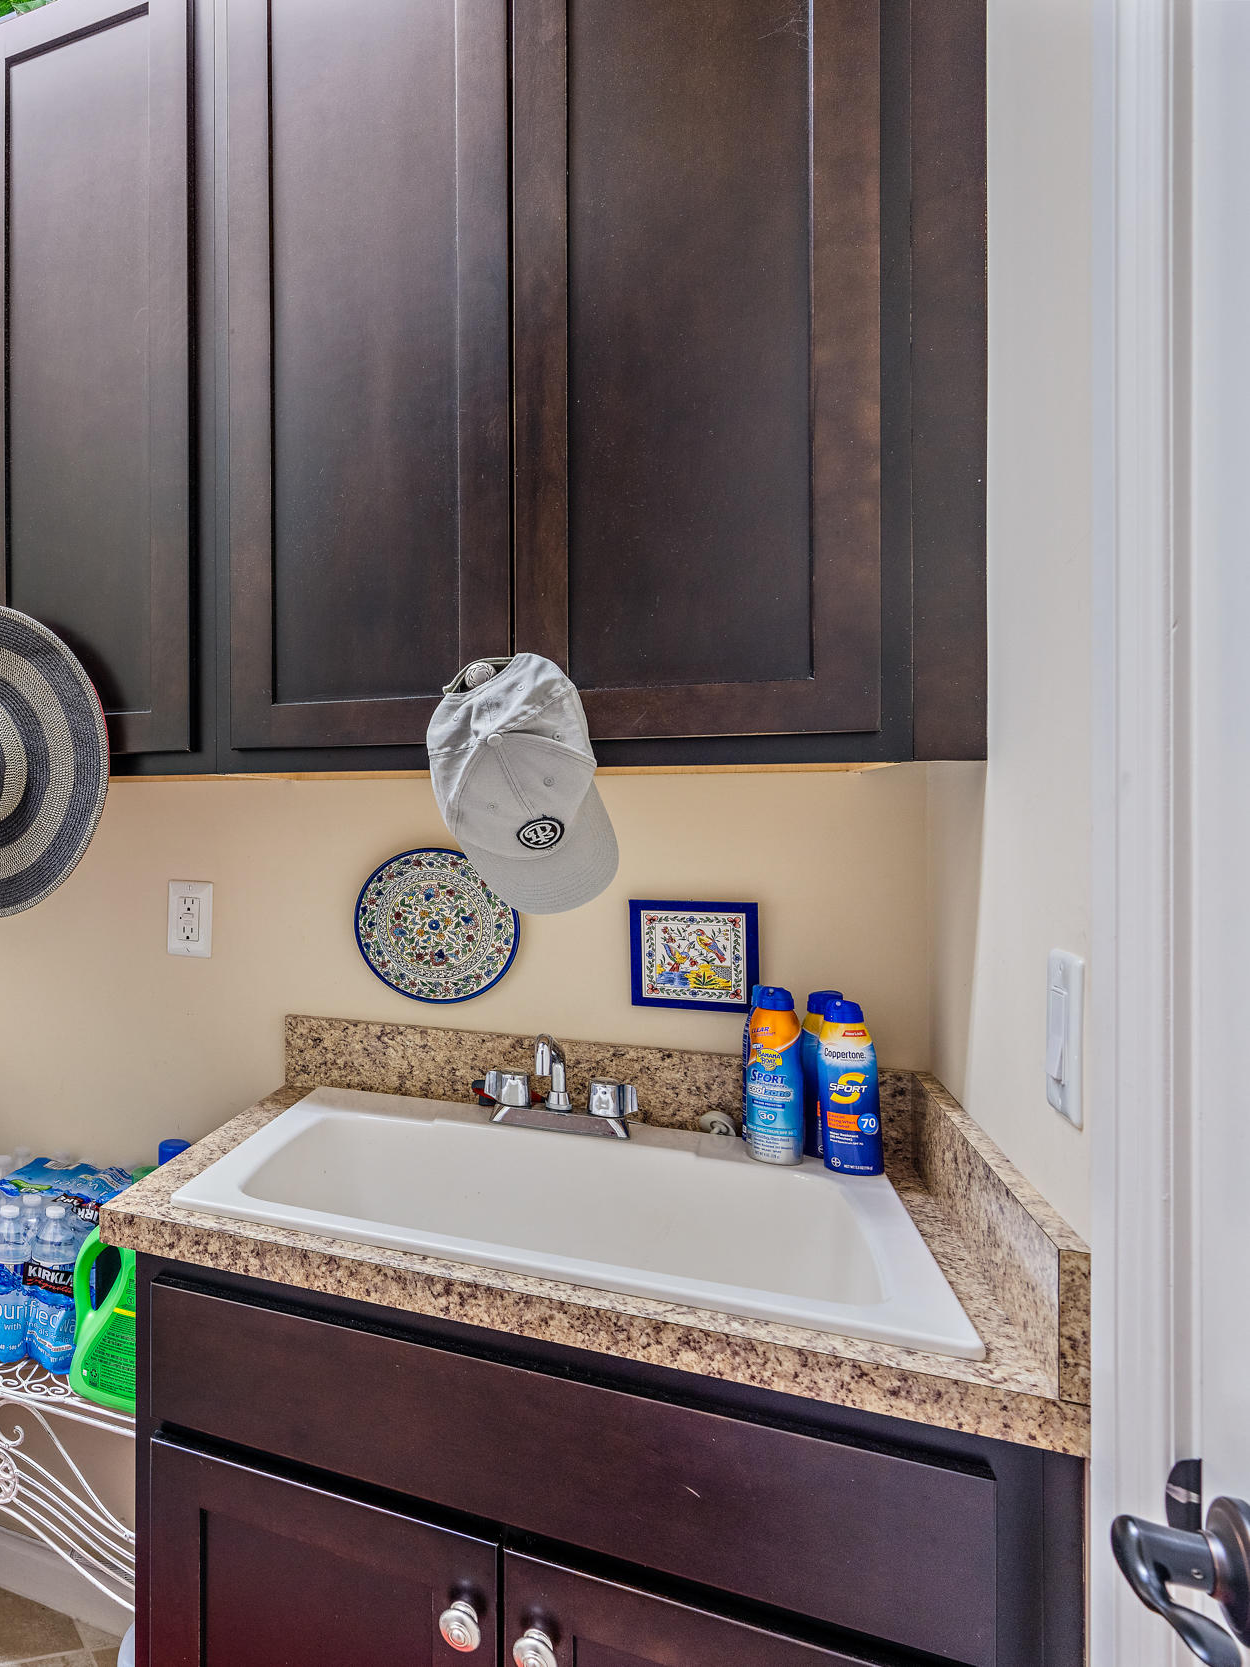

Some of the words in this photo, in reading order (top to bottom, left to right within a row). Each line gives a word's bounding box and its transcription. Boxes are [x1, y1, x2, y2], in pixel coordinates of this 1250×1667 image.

[751, 1069, 786, 1084] SPORT
[829, 1083, 868, 1094] SPORT
[759, 1111, 775, 1121] 30
[861, 1117, 876, 1129] 70
[28, 1265, 74, 1287] KIRKLA
[4, 1322, 22, 1331] with
